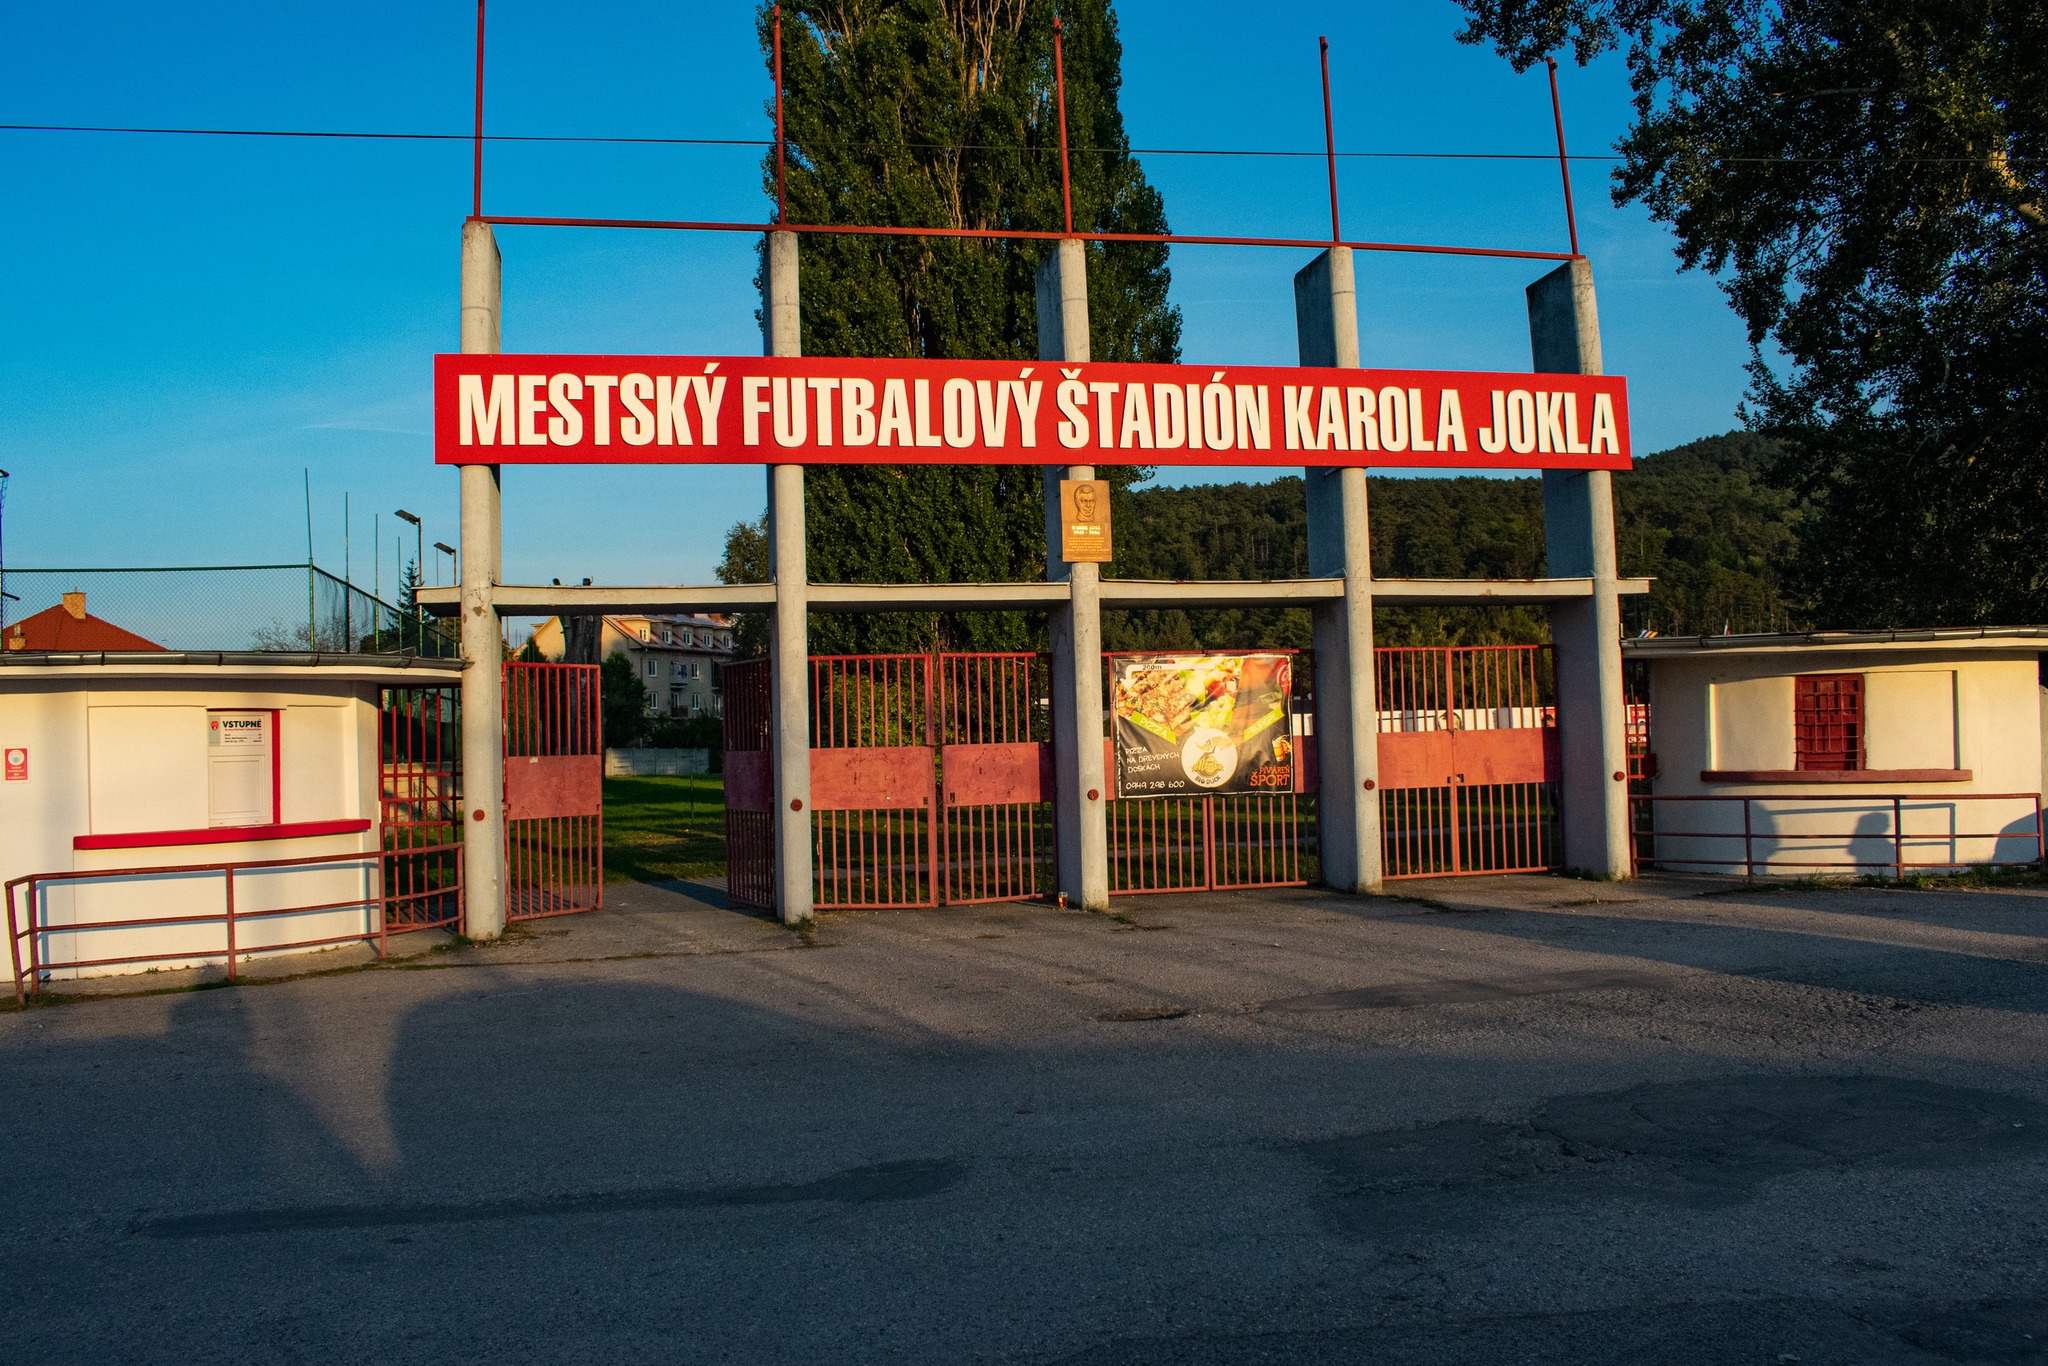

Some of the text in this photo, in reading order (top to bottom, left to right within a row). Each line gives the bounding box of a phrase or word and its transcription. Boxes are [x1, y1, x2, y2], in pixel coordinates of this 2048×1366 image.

[458, 362, 1620, 455] MESTSKÝ FUTBALOVÝ ŠTADIÓN KAROLA JOKLA
[222, 719, 262, 728] VSTUPNÉ
[1139, 717, 1168, 738] PIZZA
[1125, 746, 1148, 755] PIZZA
[1138, 751, 1180, 763] DREVENÝCH
[1127, 763, 1161, 774] DOSKÁCH
[1250, 771, 1290, 787] ŠPORT
[1125, 780, 1185, 790] 0949 298 600
